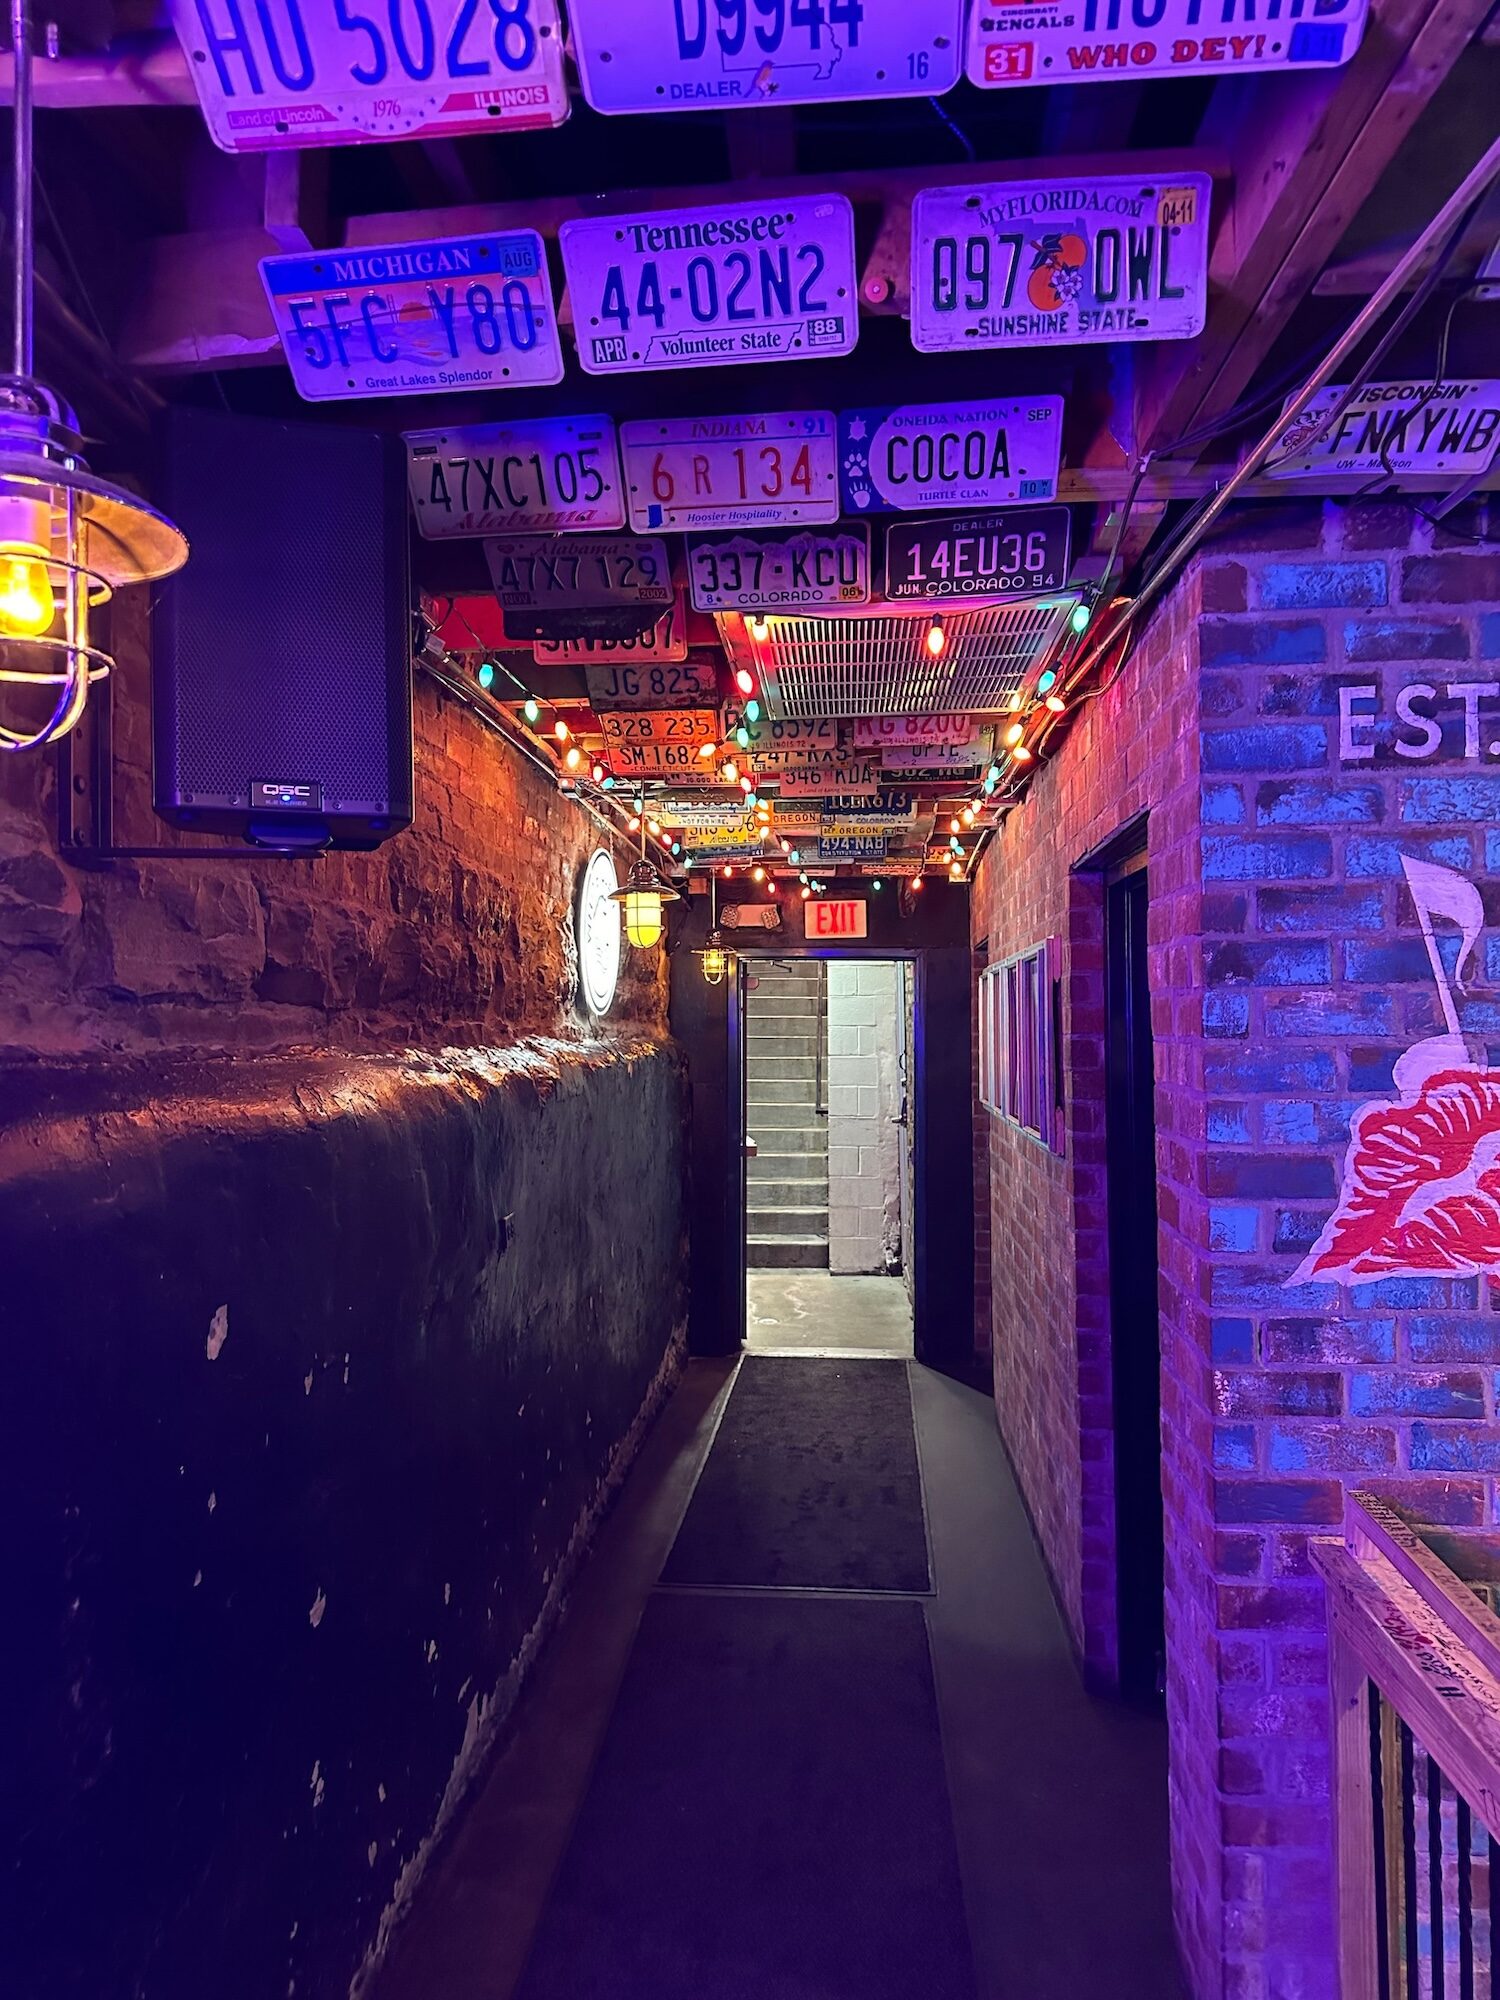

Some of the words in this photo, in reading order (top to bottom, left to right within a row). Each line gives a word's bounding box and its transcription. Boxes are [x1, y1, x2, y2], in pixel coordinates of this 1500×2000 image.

[334, 0, 535, 86] 5028
[1066, 44, 1157, 70] WHO
[1171, 35, 1267, 63] DEY!
[907, 53, 930, 80] 16
[989, 48, 1028, 74] 31
[474, 87, 547, 110] ILLINOIS
[669, 80, 743, 100] DEALER
[229, 111, 263, 128] Land
[277, 106, 326, 124] Lincoln
[373, 99, 401, 118] 1976
[979, 189, 1145, 230] MYFLORIDA.COM
[627, 211, 787, 254] Tennessee
[333, 247, 473, 283] MICHIGAN
[504, 250, 533, 269] AUG
[429, 279, 537, 359] Y80
[813, 319, 837, 334] 88
[977, 311, 1069, 338] SUNSHINE
[1077, 306, 1138, 333] STATE
[594, 340, 627, 363] APR
[660, 331, 736, 356] Volunteer
[741, 332, 782, 351] State
[365, 378, 400, 390] Great
[400, 375, 437, 387] Lakes
[438, 369, 493, 385] Splendor
[1353, 385, 1469, 404] ISCONSIN
[802, 416, 827, 434] 91
[892, 414, 947, 428] ONEIDA
[954, 409, 1008, 423] NATION
[1027, 408, 1052, 422] SEP
[690, 419, 768, 437] INDIANA
[1328, 408, 1500, 454] FNKYWB
[886, 428, 1012, 484] COCOA
[1336, 460, 1357, 469] UW
[1366, 459, 1412, 469] Maison
[430, 448, 604, 513] 47XC105
[652, 452, 675, 502] 6
[692, 454, 712, 494] R
[732, 443, 812, 499] 134
[918, 492, 954, 501] TURTLE
[960, 488, 989, 498] CLAN
[1023, 482, 1037, 495] 10
[458, 509, 599, 530] Alabama
[687, 513, 726, 523] Hoosier
[728, 508, 782, 522] Hospitality
[952, 519, 1004, 532] DEALER
[529, 542, 618, 556] Alabama
[907, 532, 1046, 581] 14EU36
[595, 555, 658, 590] 129
[629, 588, 666, 601] 2002
[841, 586, 857, 598] 06
[894, 584, 921, 596] JUN
[925, 575, 1026, 595] COLORADO
[1032, 573, 1055, 587] 94
[505, 593, 530, 604] NOV
[706, 594, 714, 605] 8
[738, 590, 823, 604] COLORADO
[605, 667, 640, 697] JG
[651, 667, 701, 695] 825
[606, 718, 653, 737] 328
[664, 717, 710, 736] 235
[1338, 682, 1500, 761] EST.
[620, 746, 645, 766] SM
[652, 745, 702, 765] 1682
[763, 741, 794, 749] ILLINOIS
[262, 784, 310, 796] QSC
[774, 814, 816, 823] OREGON
[816, 903, 857, 934] EXIT
